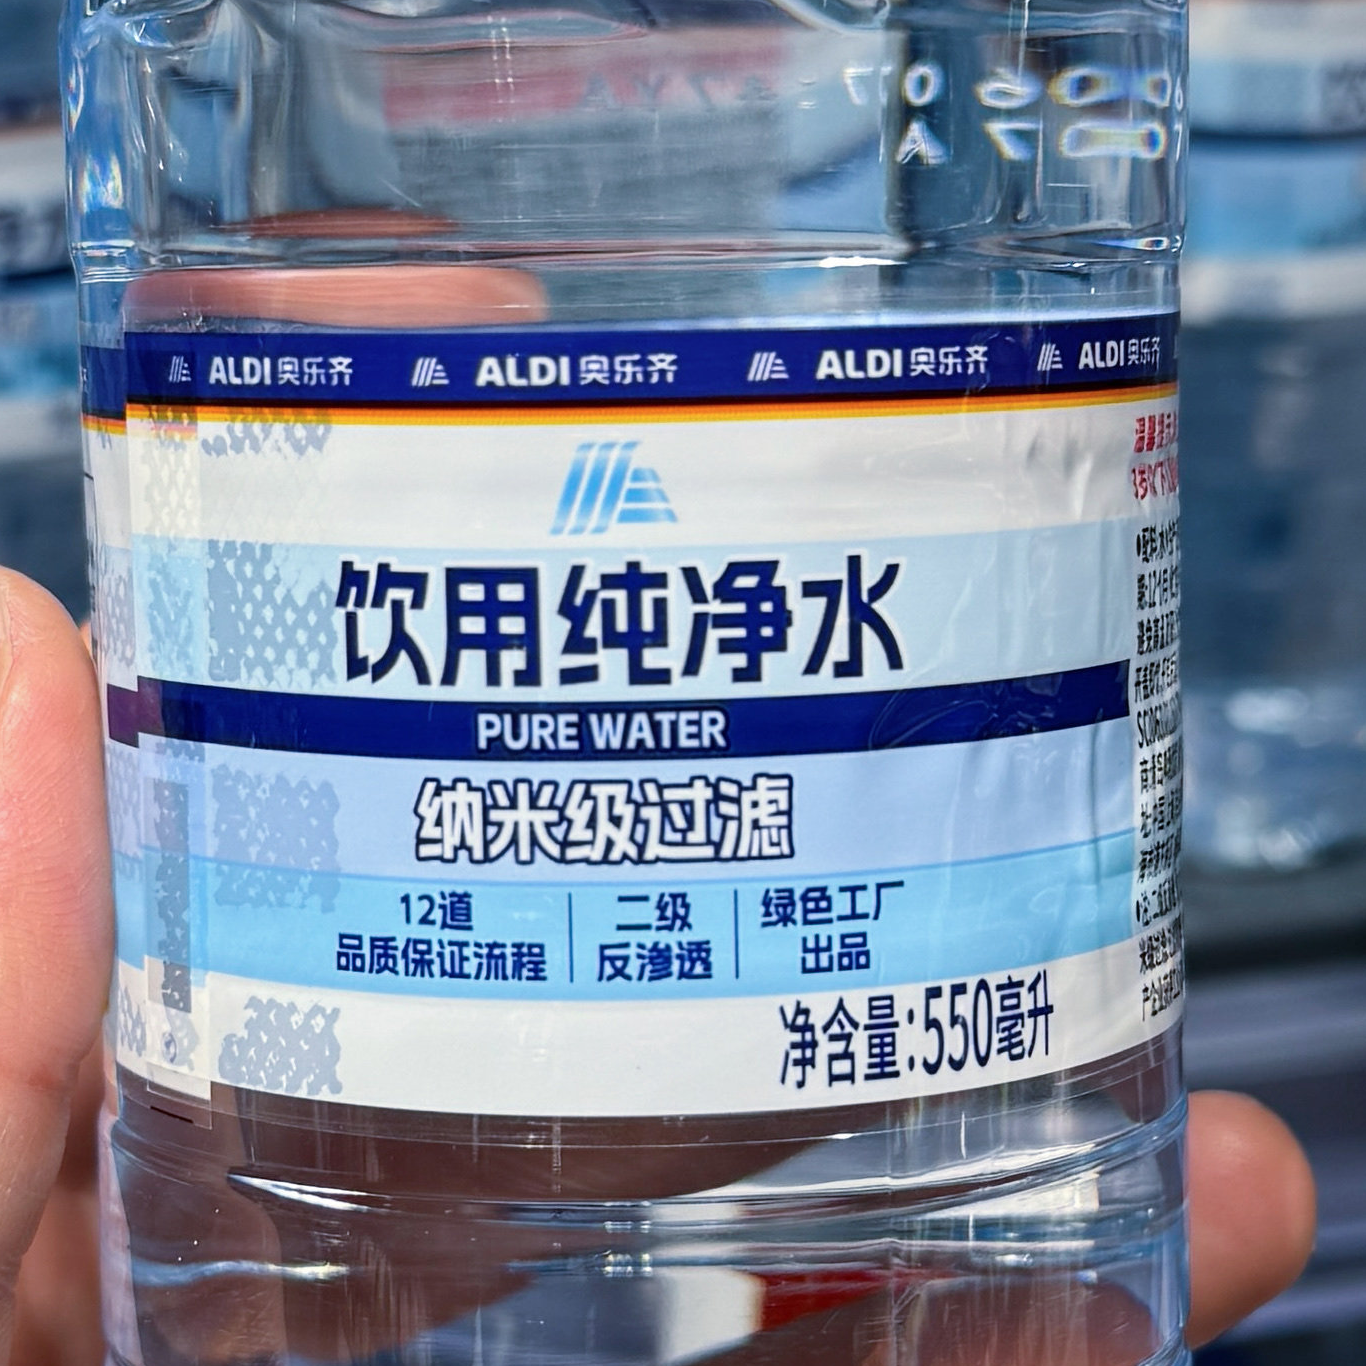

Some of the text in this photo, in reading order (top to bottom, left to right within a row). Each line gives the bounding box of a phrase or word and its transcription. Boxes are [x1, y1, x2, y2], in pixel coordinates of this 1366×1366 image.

[208, 355, 271, 386] ALDI
[276, 355, 354, 387] 奥乐齐
[475, 355, 571, 387] ALDI
[578, 352, 679, 386] 奥乐齐
[815, 347, 903, 380] ALDI
[909, 344, 990, 378] 奥乐齐
[1078, 339, 1125, 370] ALDI
[334, 553, 906, 688] 饮用纯净水
[476, 709, 728, 750] PURE WATER
[414, 774, 794, 865] 纳米级过滤
[398, 891, 475, 933] 12道
[615, 891, 693, 934] 二级
[759, 879, 907, 928] 绿色工厂
[335, 937, 548, 983] 品质保证流程
[596, 939, 713, 984] 反渗透
[800, 933, 872, 975] 出品
